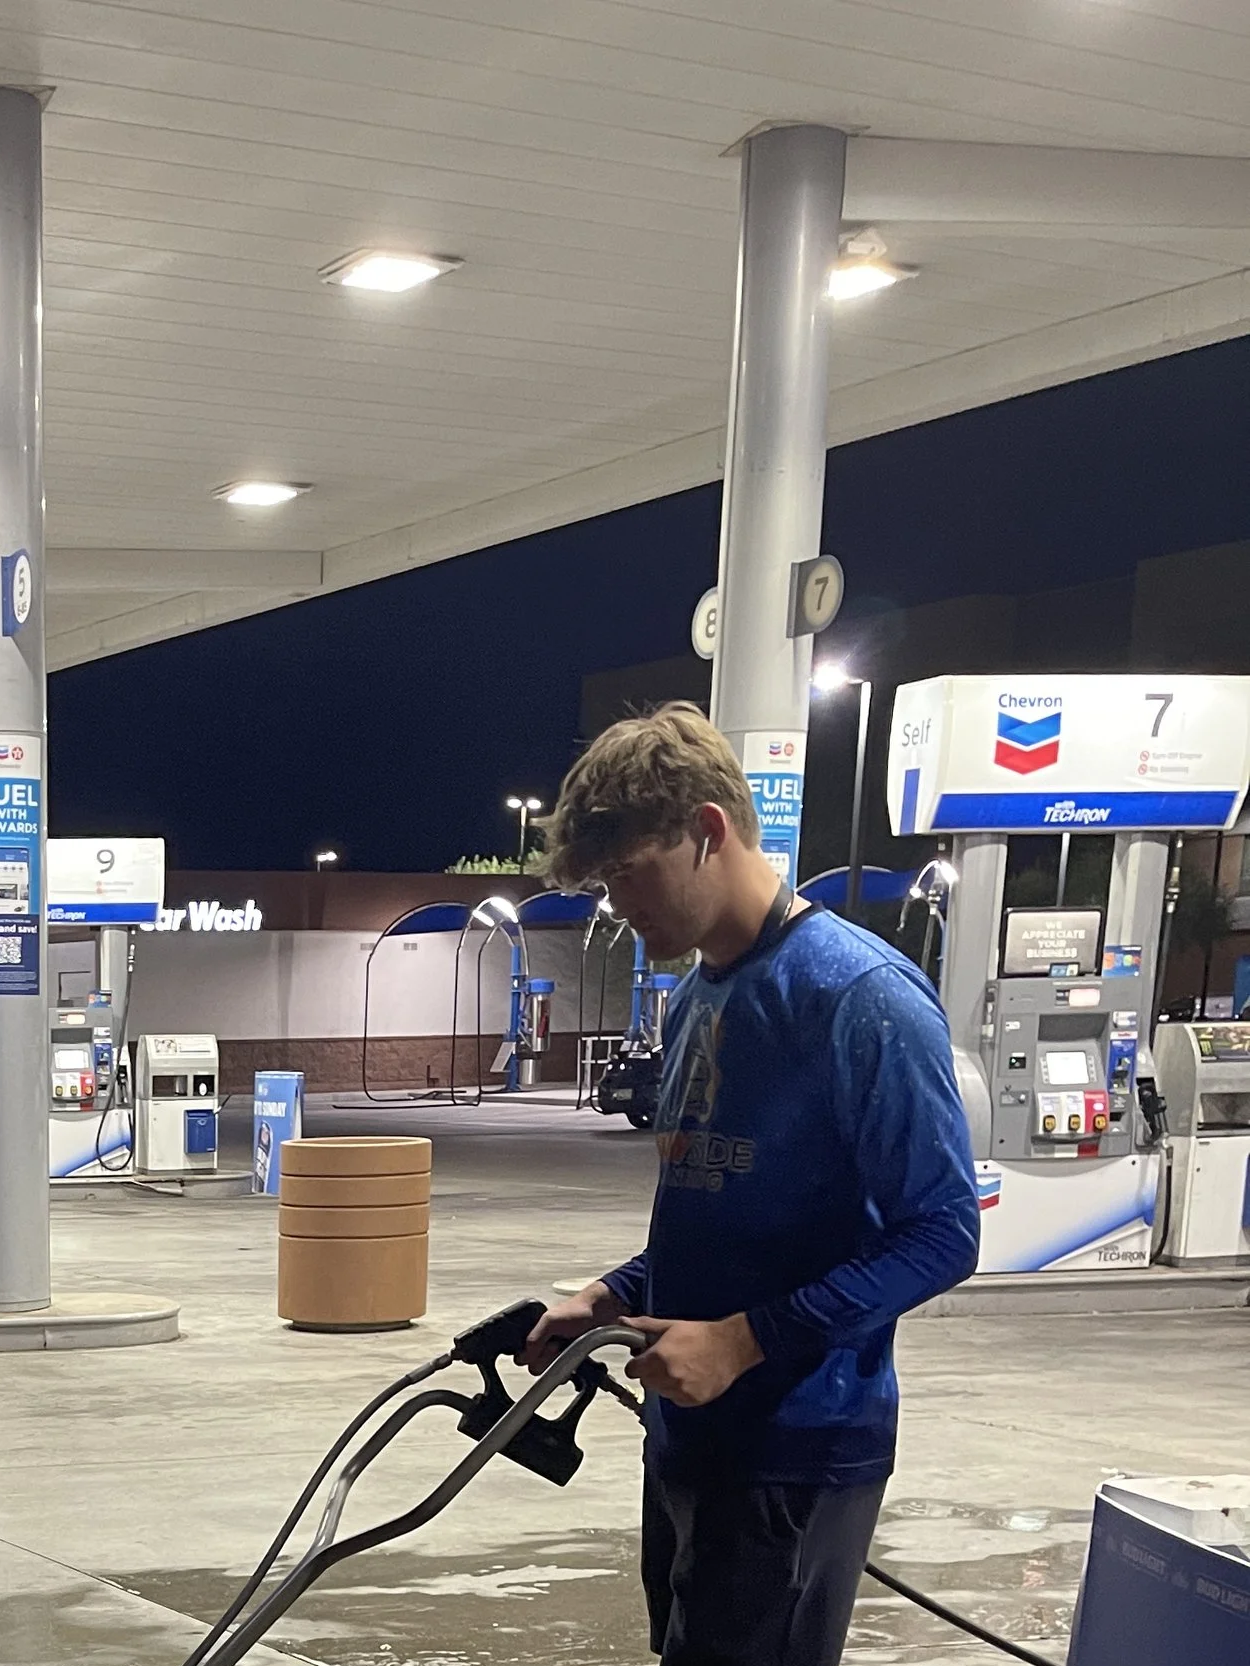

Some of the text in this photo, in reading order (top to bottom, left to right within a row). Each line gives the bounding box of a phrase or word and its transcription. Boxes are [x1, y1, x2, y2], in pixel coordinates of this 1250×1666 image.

[814, 576, 829, 611] 7
[998, 693, 1063, 708] Chevron
[1144, 693, 1174, 738] 7
[901, 717, 932, 747] Self
[761, 802, 793, 813] WITH
[1043, 805, 1111, 824] TECHRON
[96, 849, 116, 874] 9
[139, 899, 263, 932] ar Wash
[15, 924, 38, 935] save!
[1021, 930, 1086, 940] APPRECIATE
[1038, 940, 1067, 948] YOUR
[1026, 948, 1078, 958] BUSINESS
